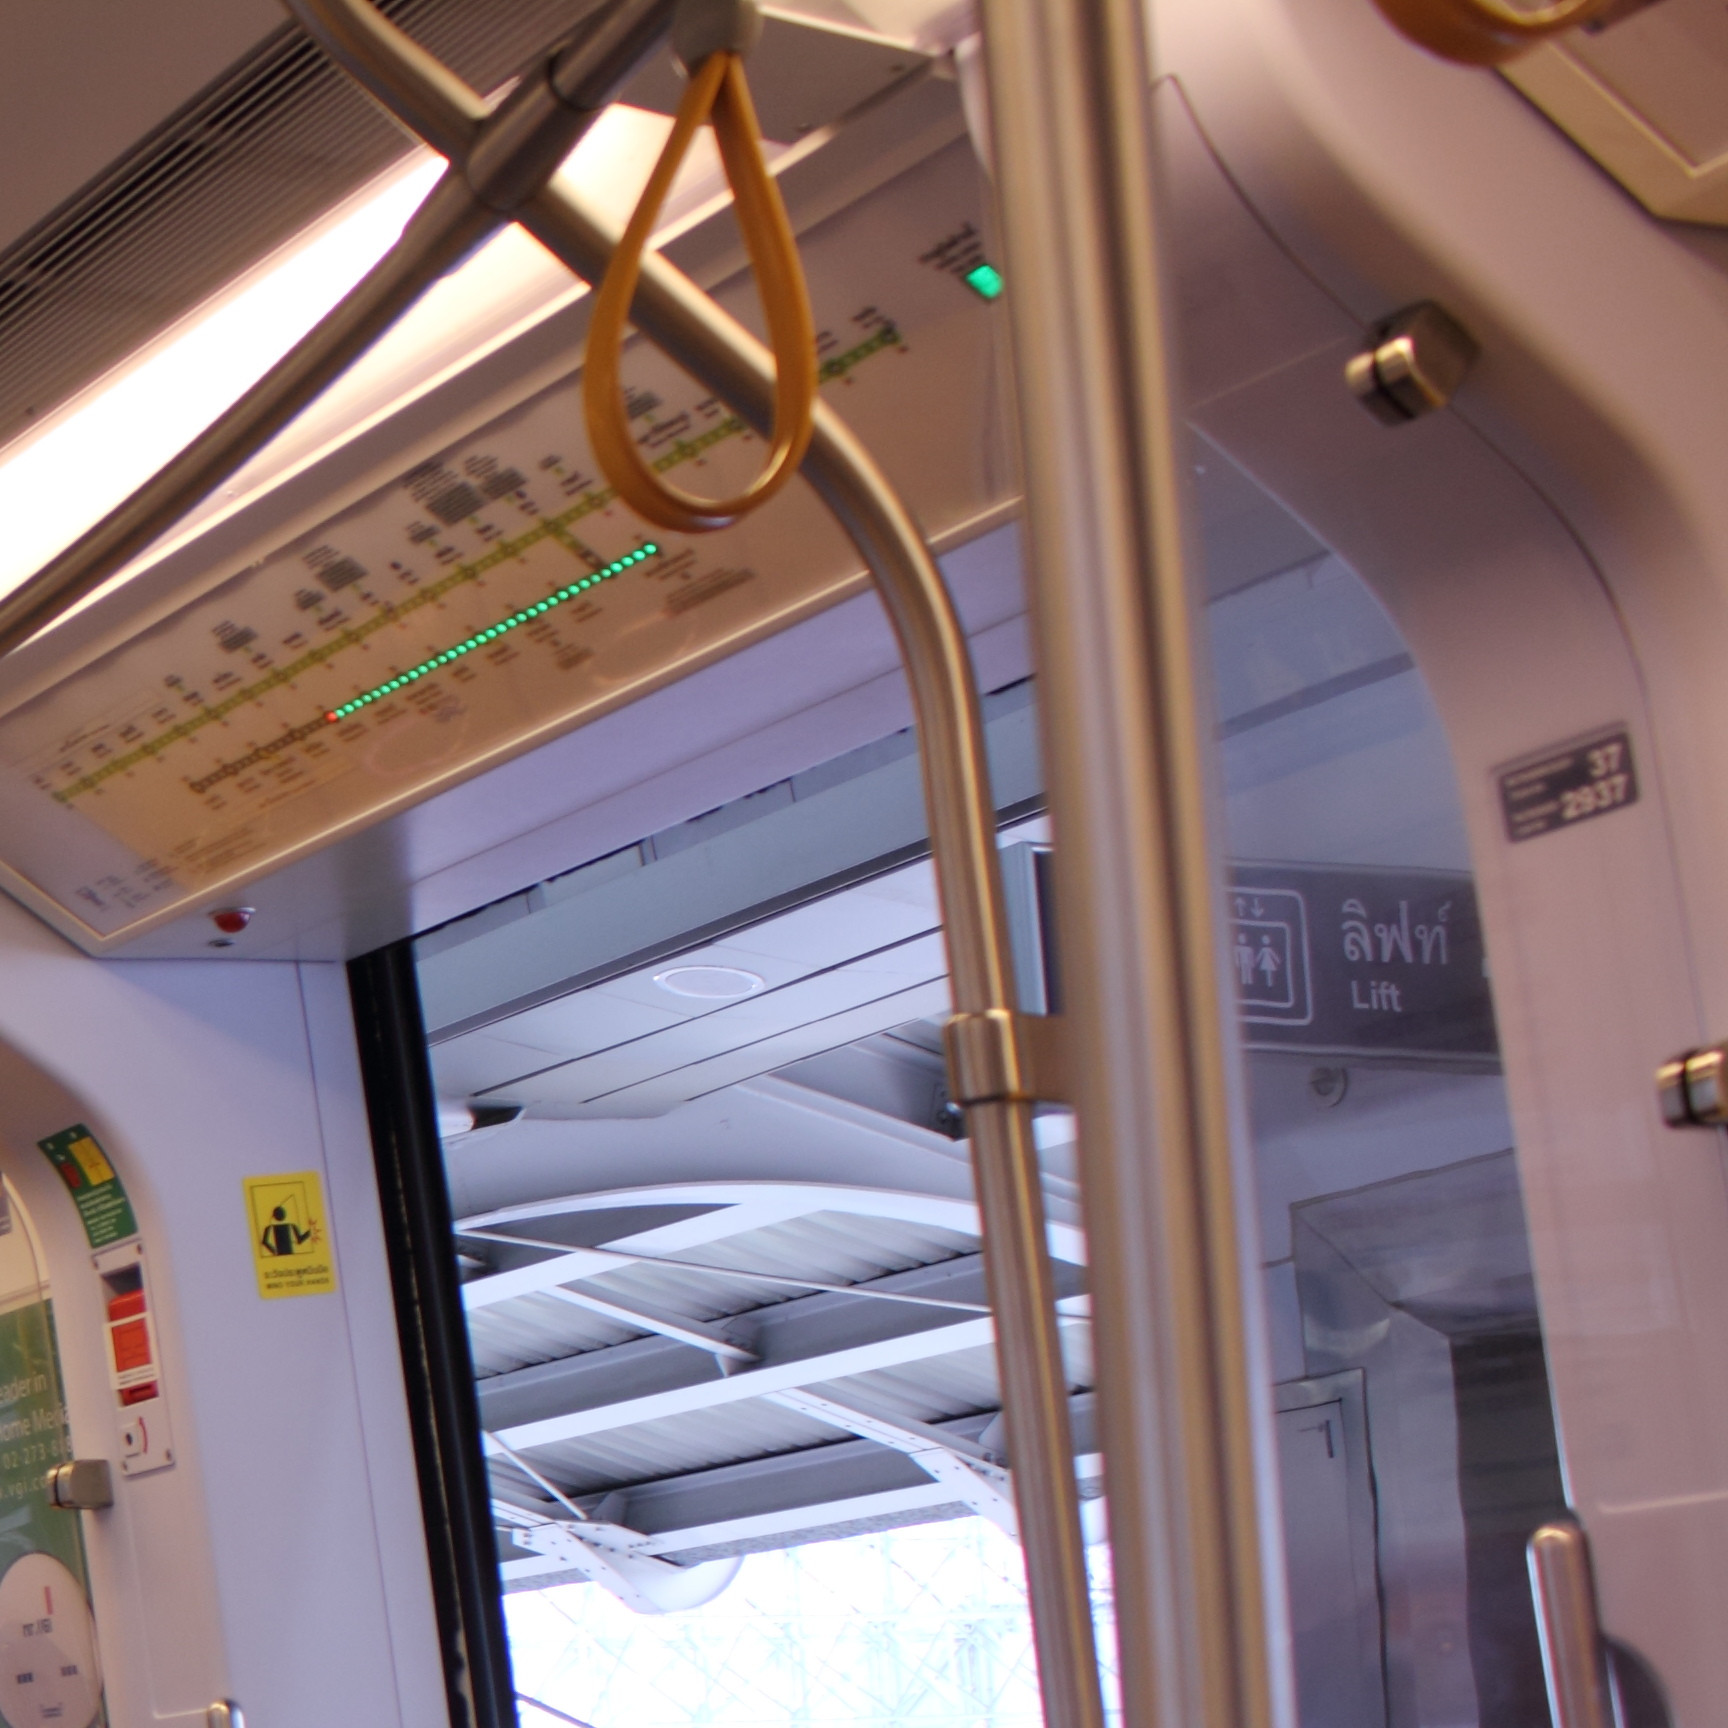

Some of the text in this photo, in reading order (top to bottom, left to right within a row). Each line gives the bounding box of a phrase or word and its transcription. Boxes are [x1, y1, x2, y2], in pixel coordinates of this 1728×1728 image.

[1586, 742, 1622, 778] 37
[1560, 773, 1629, 821] 2937
[1342, 898, 1452, 965] ลิฟท์
[1351, 980, 1402, 1012] Lift
